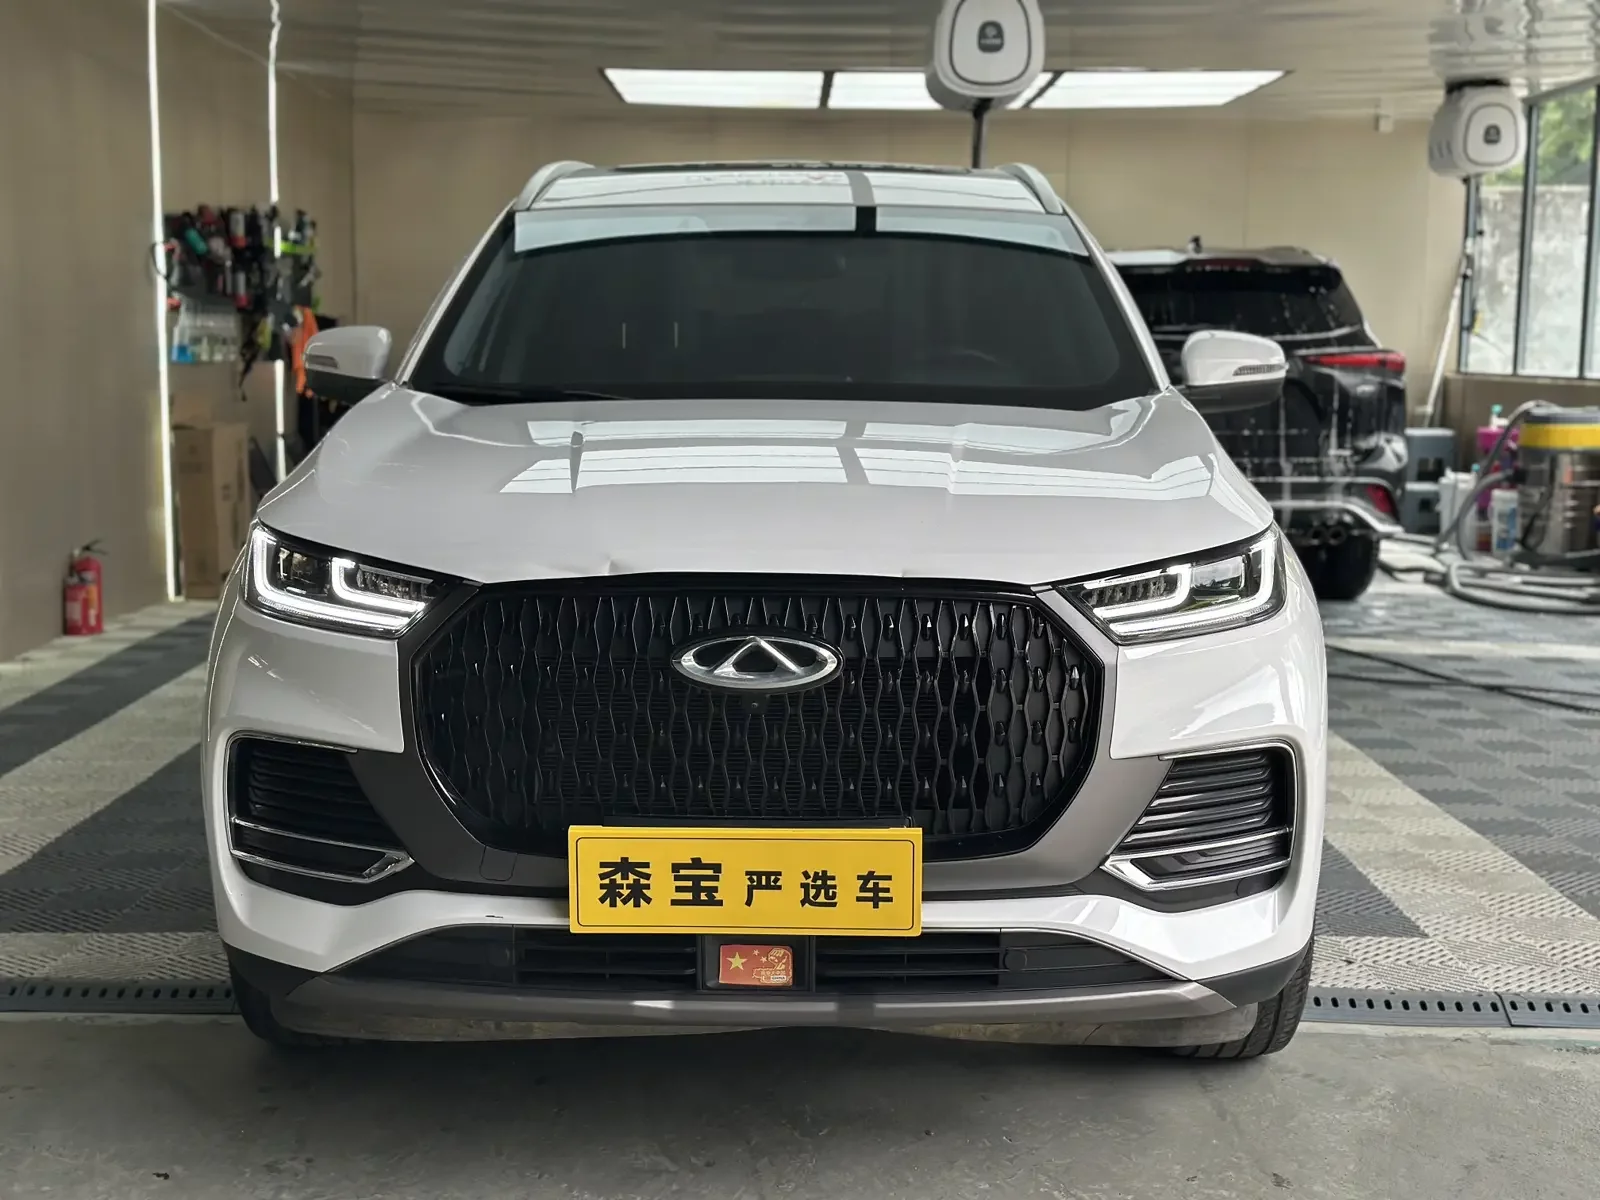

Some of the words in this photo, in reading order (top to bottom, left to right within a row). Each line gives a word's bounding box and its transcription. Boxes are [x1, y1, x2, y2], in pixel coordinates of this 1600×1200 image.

[597, 856, 894, 910] 森宝严选车
